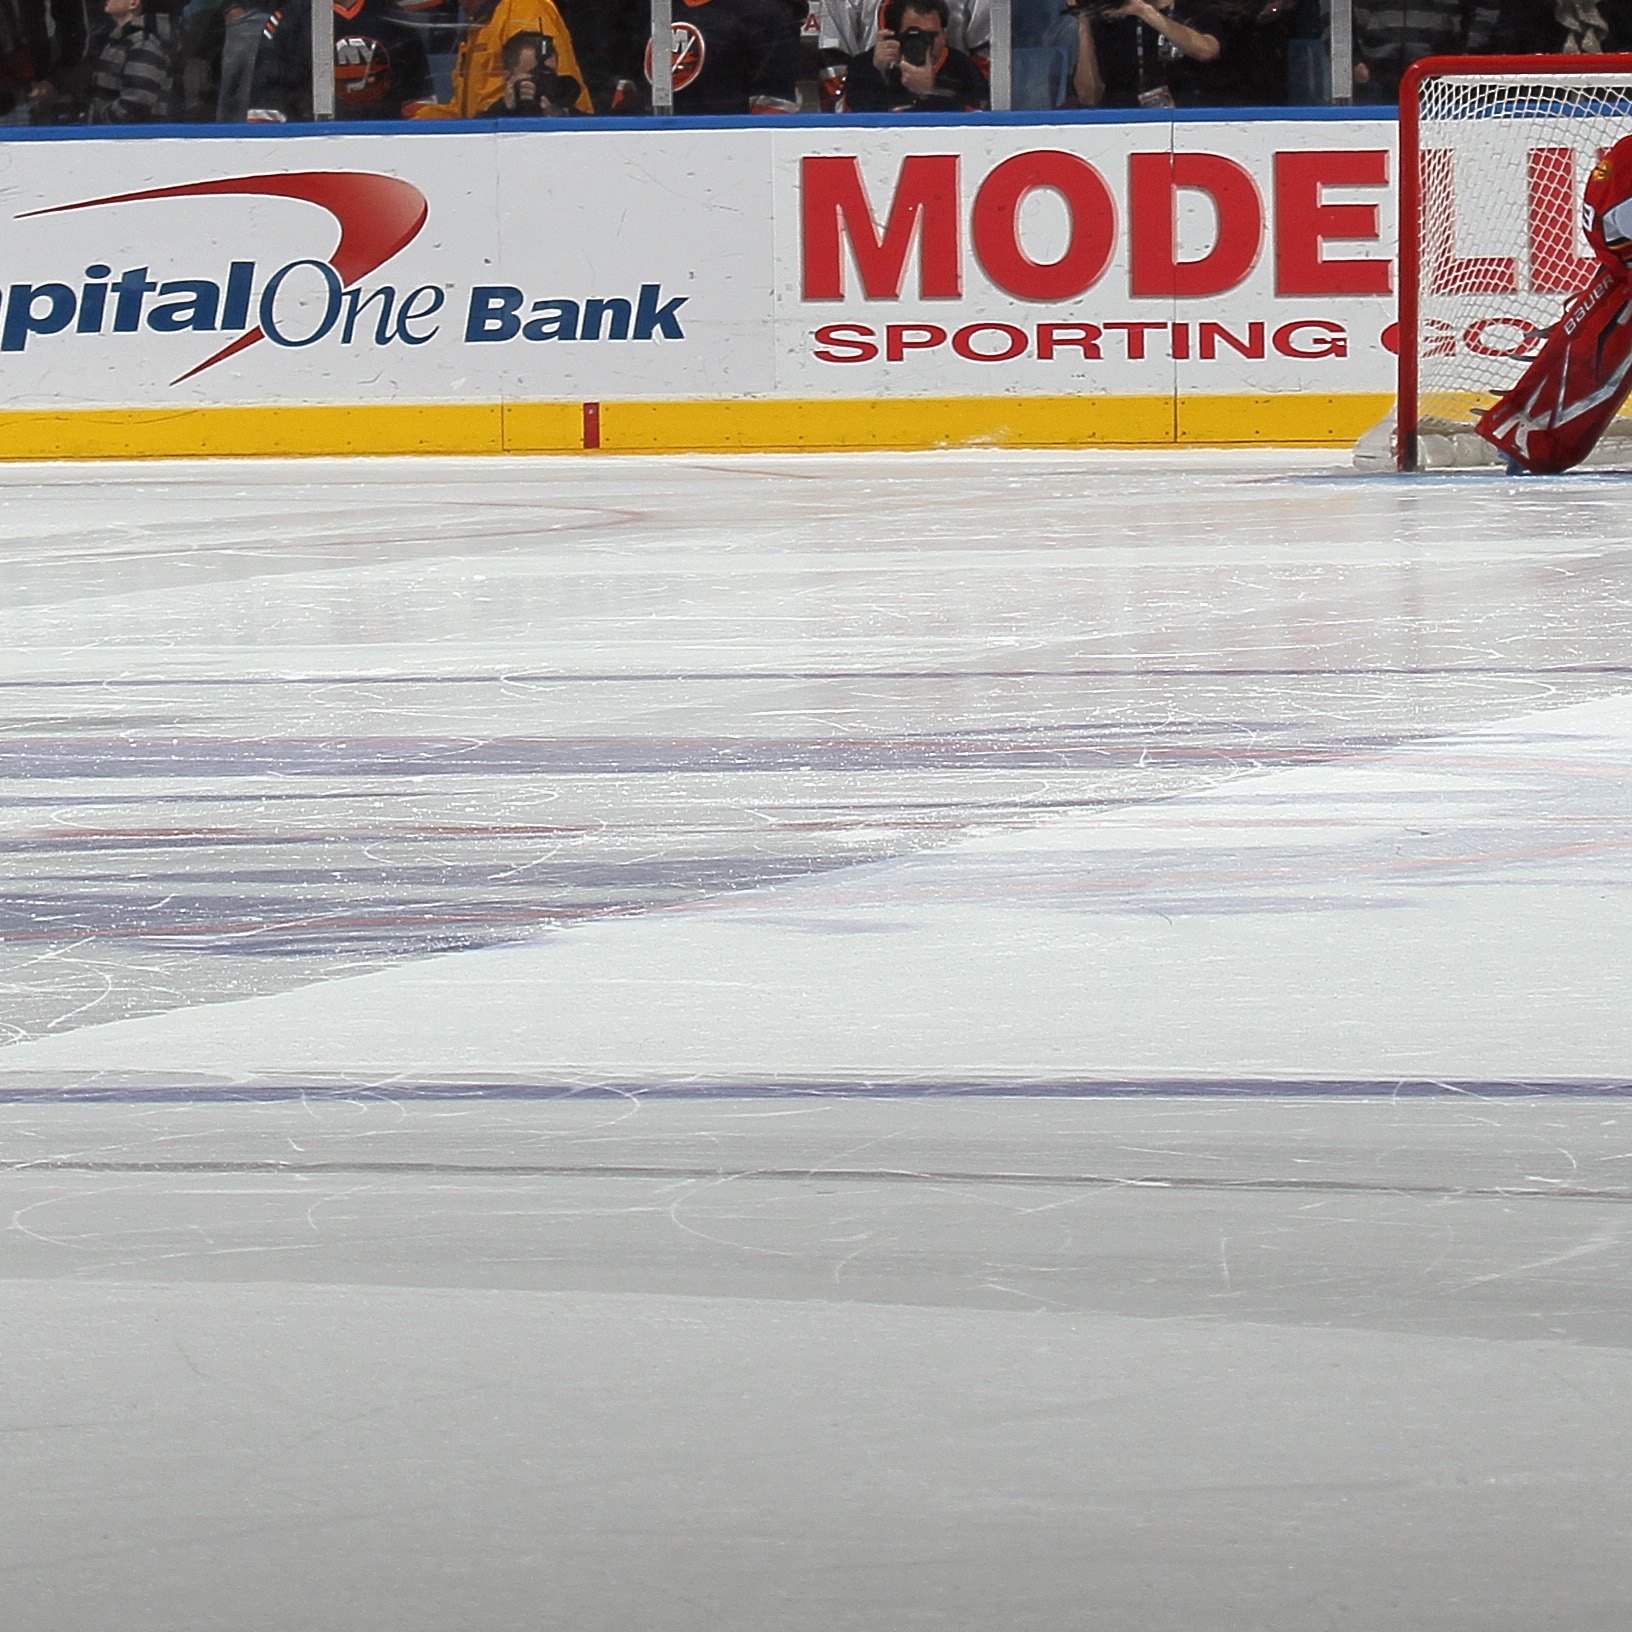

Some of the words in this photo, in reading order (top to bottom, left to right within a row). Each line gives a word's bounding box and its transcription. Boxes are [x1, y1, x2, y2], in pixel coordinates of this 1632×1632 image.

[464, 282, 689, 342] Bank
[1563, 274, 1615, 336] BAUER
[814, 319, 1347, 363] SPORTING
